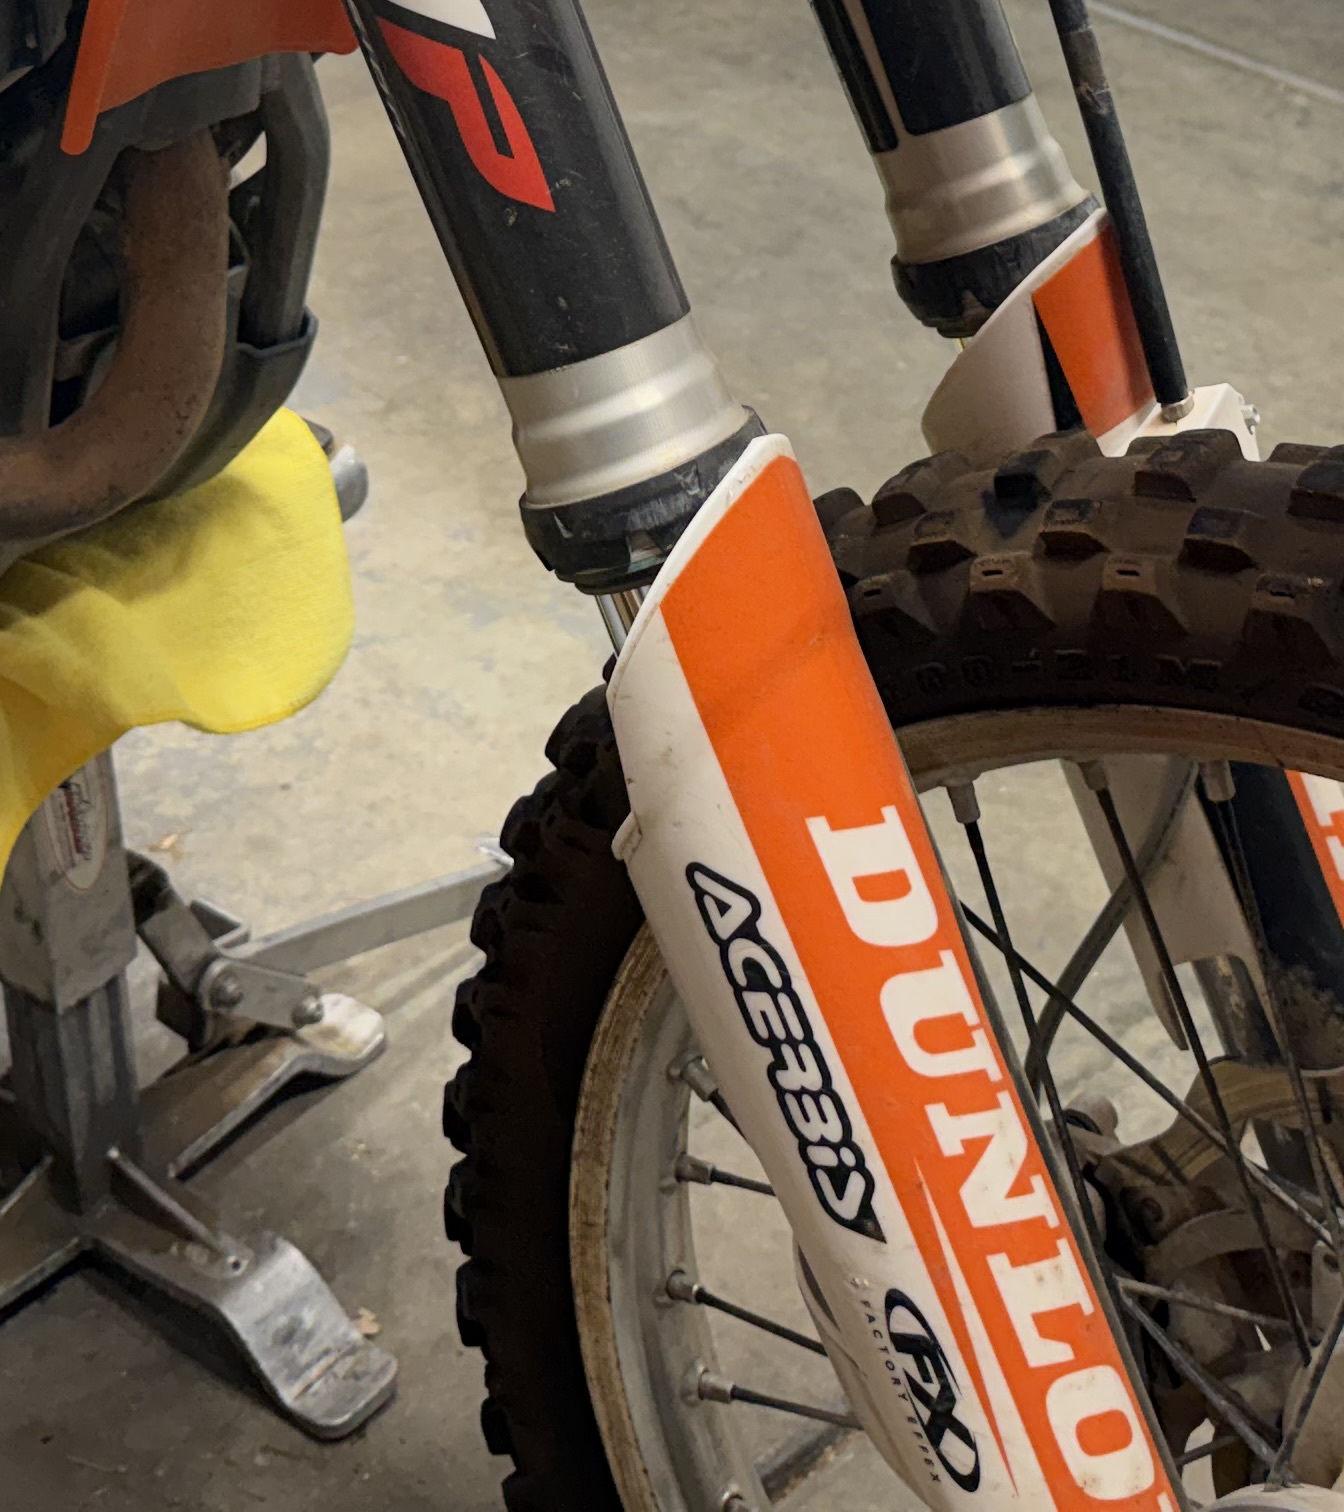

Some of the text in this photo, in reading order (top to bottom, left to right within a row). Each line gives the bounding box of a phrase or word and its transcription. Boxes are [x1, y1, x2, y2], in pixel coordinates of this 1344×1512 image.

[804, 805, 1179, 1512] DUNLO
[860, 1298, 942, 1484] FACTORY EFFEX
